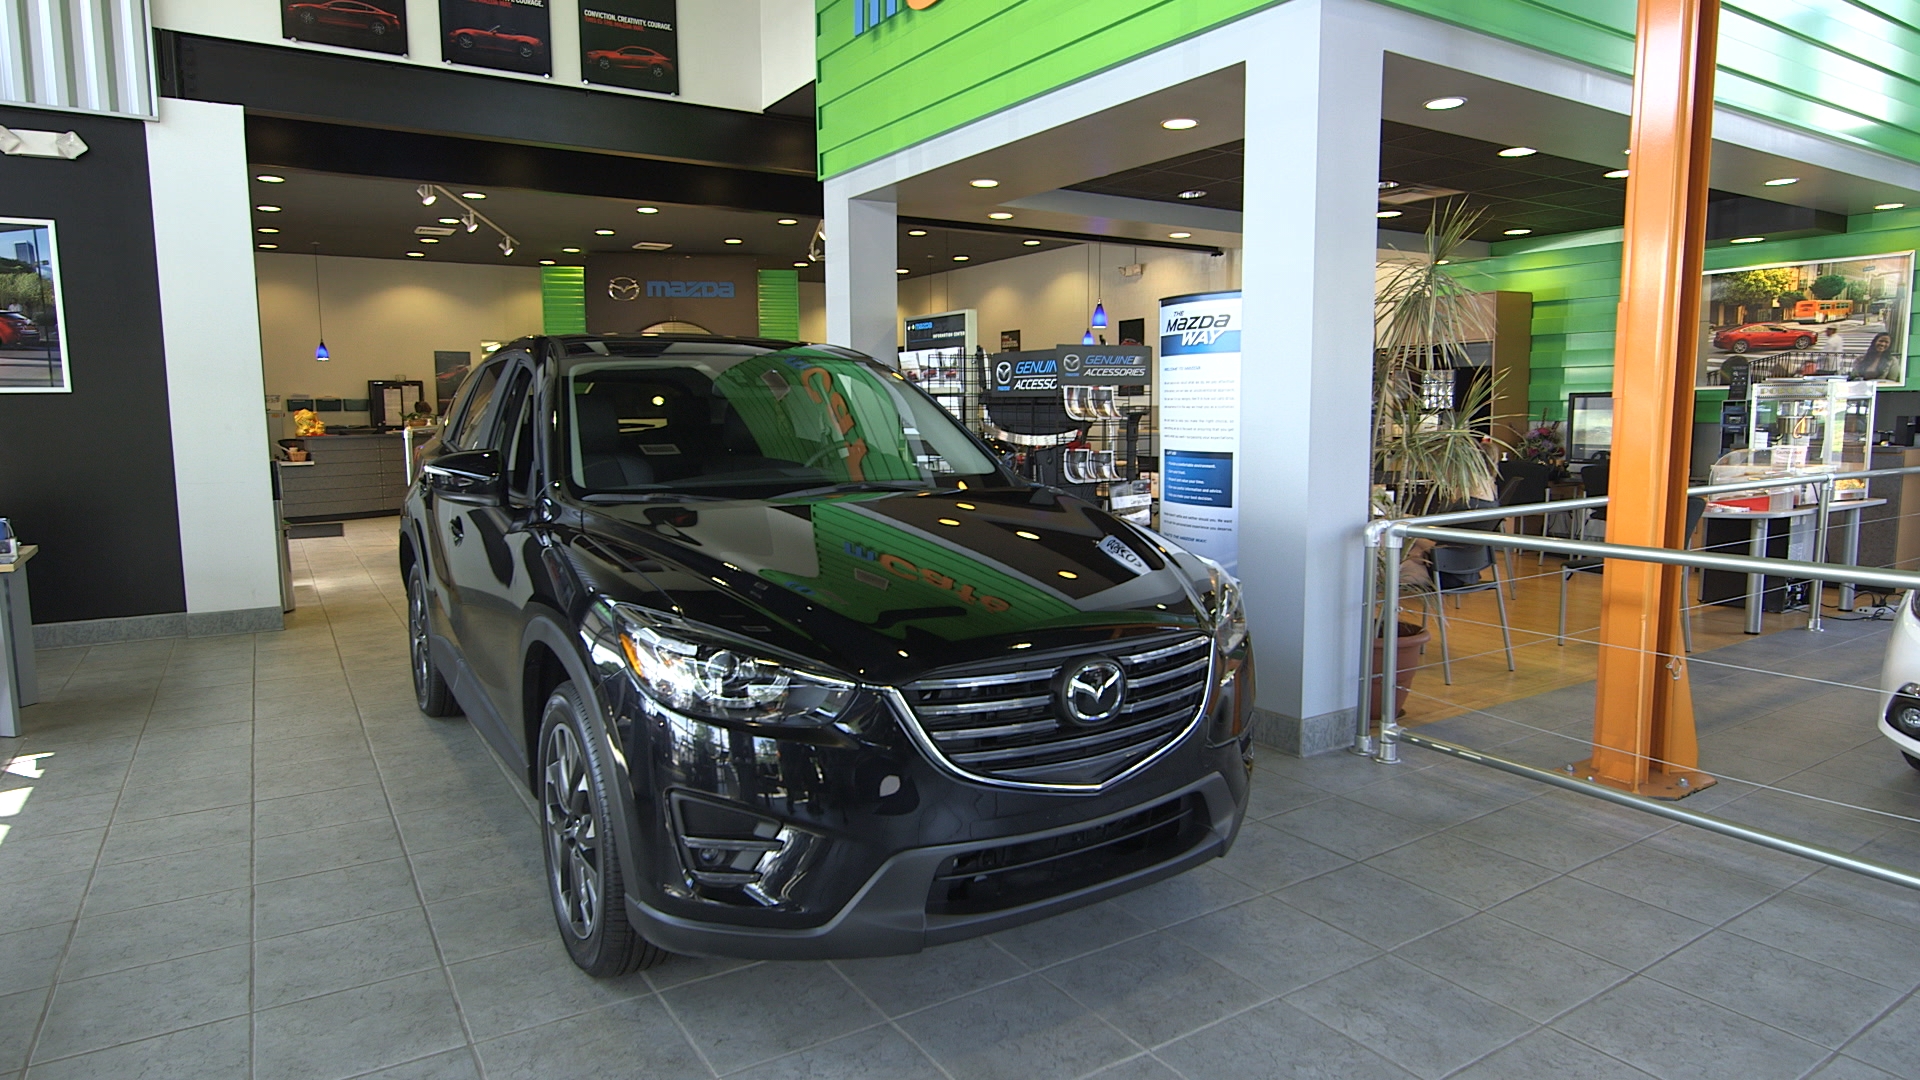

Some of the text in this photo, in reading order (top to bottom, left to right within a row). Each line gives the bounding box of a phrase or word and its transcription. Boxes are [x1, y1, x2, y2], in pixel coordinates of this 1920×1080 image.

[584, 9, 673, 31] CONVICTION. CREATIVITY. COURAGE.
[1181, 329, 1226, 347] WAY
[1084, 355, 1135, 365] GENUINE
[1083, 367, 1146, 377] ACCESSORIES
